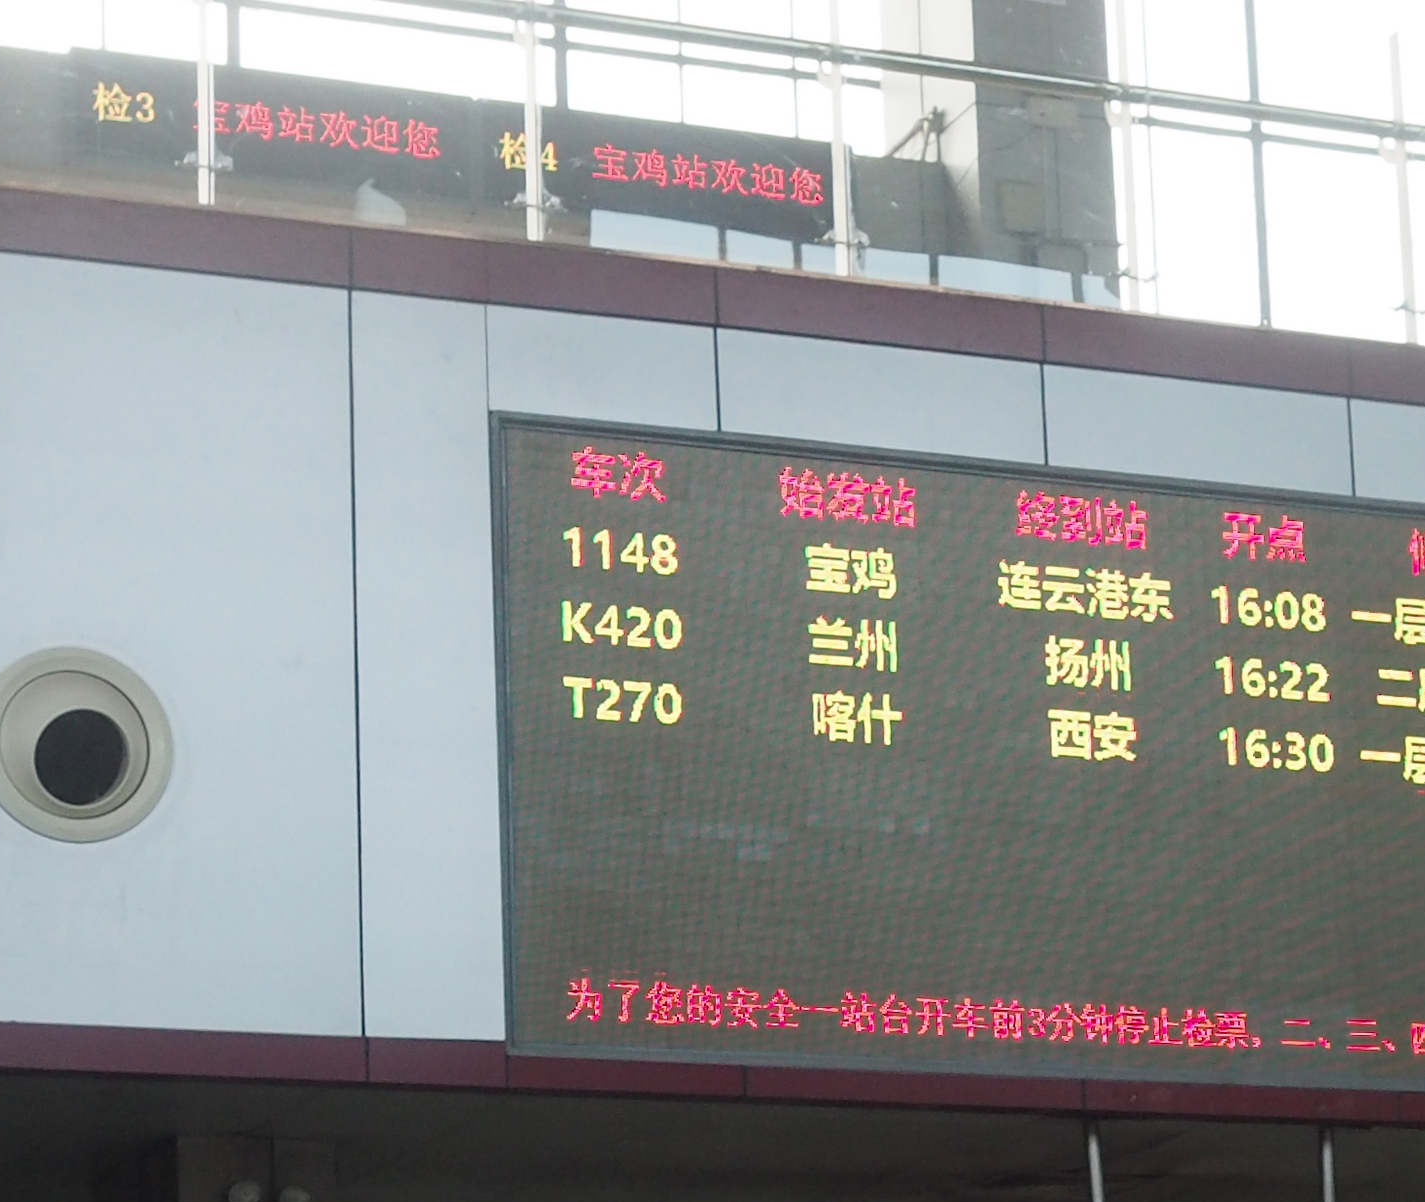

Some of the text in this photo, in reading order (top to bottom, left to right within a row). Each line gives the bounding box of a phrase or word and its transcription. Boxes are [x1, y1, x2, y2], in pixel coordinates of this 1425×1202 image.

[92, 81, 156, 123] 检3
[592, 144, 824, 205] 宝鸡站欢迎您
[572, 447, 666, 502] 车次
[778, 467, 917, 528] 始发站
[1015, 491, 1149, 550] 终到站
[1222, 512, 1307, 563] 开点
[562, 527, 679, 576] 1148
[805, 544, 898, 600] 宝鸡
[998, 561, 1174, 622] 连云港东
[1212, 585, 1326, 633] 16:08
[561, 600, 683, 650] K420
[808, 616, 899, 672] 兰州
[1045, 635, 1132, 692] 扬州
[1214, 656, 1332, 703] 16:22
[562, 676, 683, 725] T270
[812, 691, 904, 746] 喀什
[1048, 709, 1138, 762] 西安
[1218, 727, 1335, 773] 16:30
